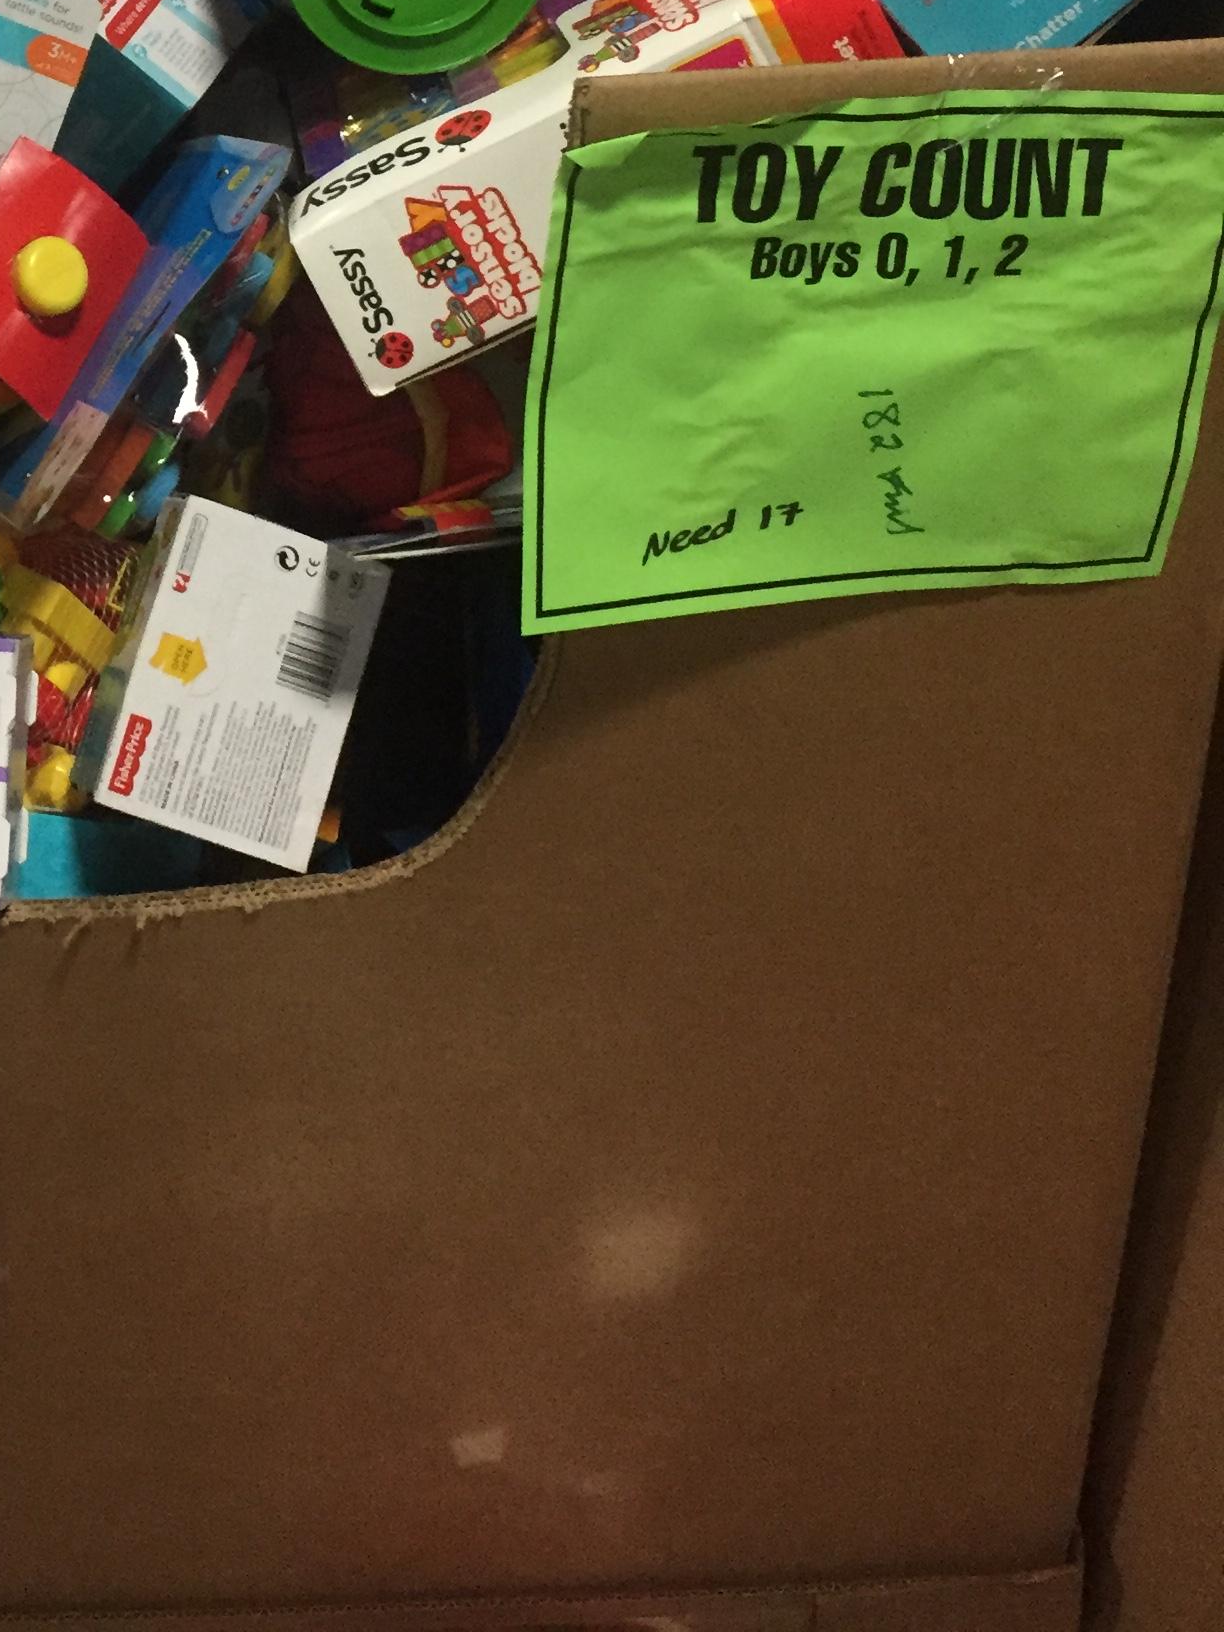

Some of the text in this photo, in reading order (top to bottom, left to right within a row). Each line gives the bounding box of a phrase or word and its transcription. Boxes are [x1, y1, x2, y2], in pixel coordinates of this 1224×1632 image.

[53, 0, 70, 15] for
[300, 136, 431, 218] Sassy
[692, 138, 1124, 224] TOY COUNT
[439, 186, 521, 317] sensory
[749, 231, 1029, 287] Boys 0, 1, 2
[333, 247, 394, 334] Sassy
[643, 500, 805, 569] Need 17
[114, 720, 145, 790] Fisher-Price
